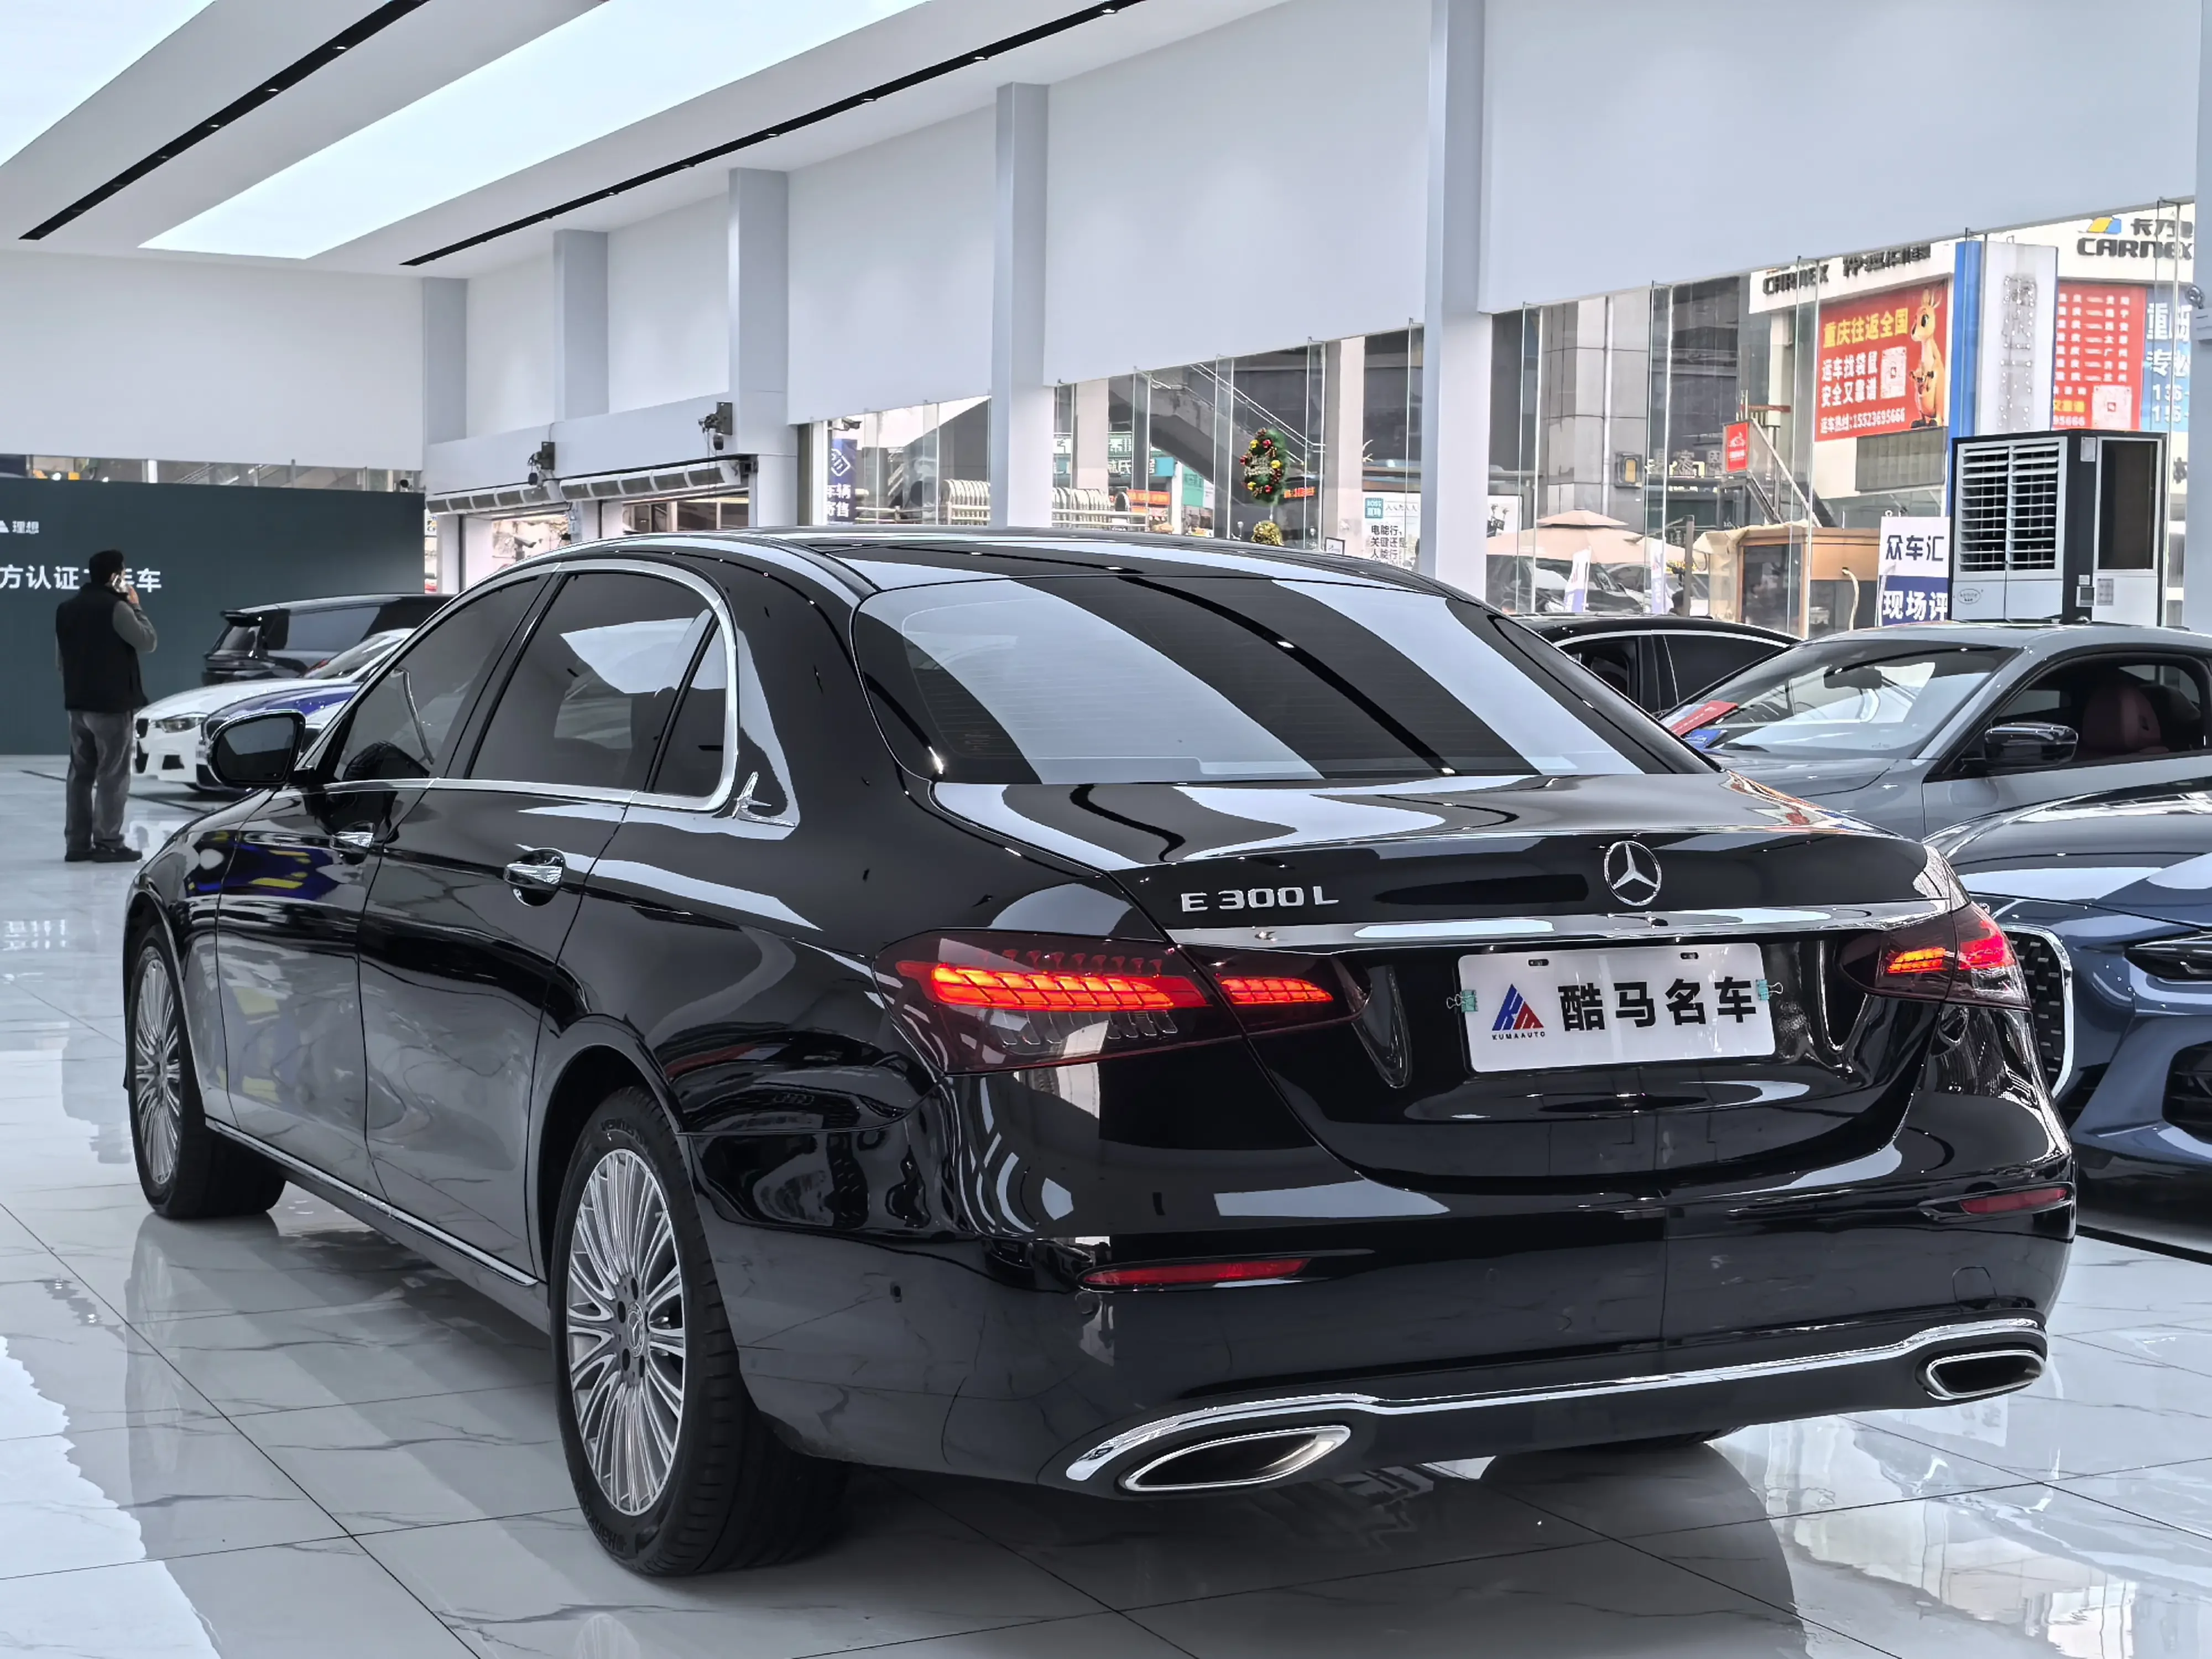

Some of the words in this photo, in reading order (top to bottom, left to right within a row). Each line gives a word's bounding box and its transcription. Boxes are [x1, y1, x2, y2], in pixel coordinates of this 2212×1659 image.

[1823, 307, 1908, 348] 重庆往返全国
[12, 520, 40, 534] 理想
[1885, 534, 1945, 562] 众车汇
[1882, 589, 1948, 622] 现场评
[1181, 891, 1209, 912] E
[1218, 886, 1305, 910] 300
[1312, 885, 1340, 906] L
[1557, 976, 1756, 1031] 酷马名车
[1491, 1031, 1546, 1041] KUMAAUTO
